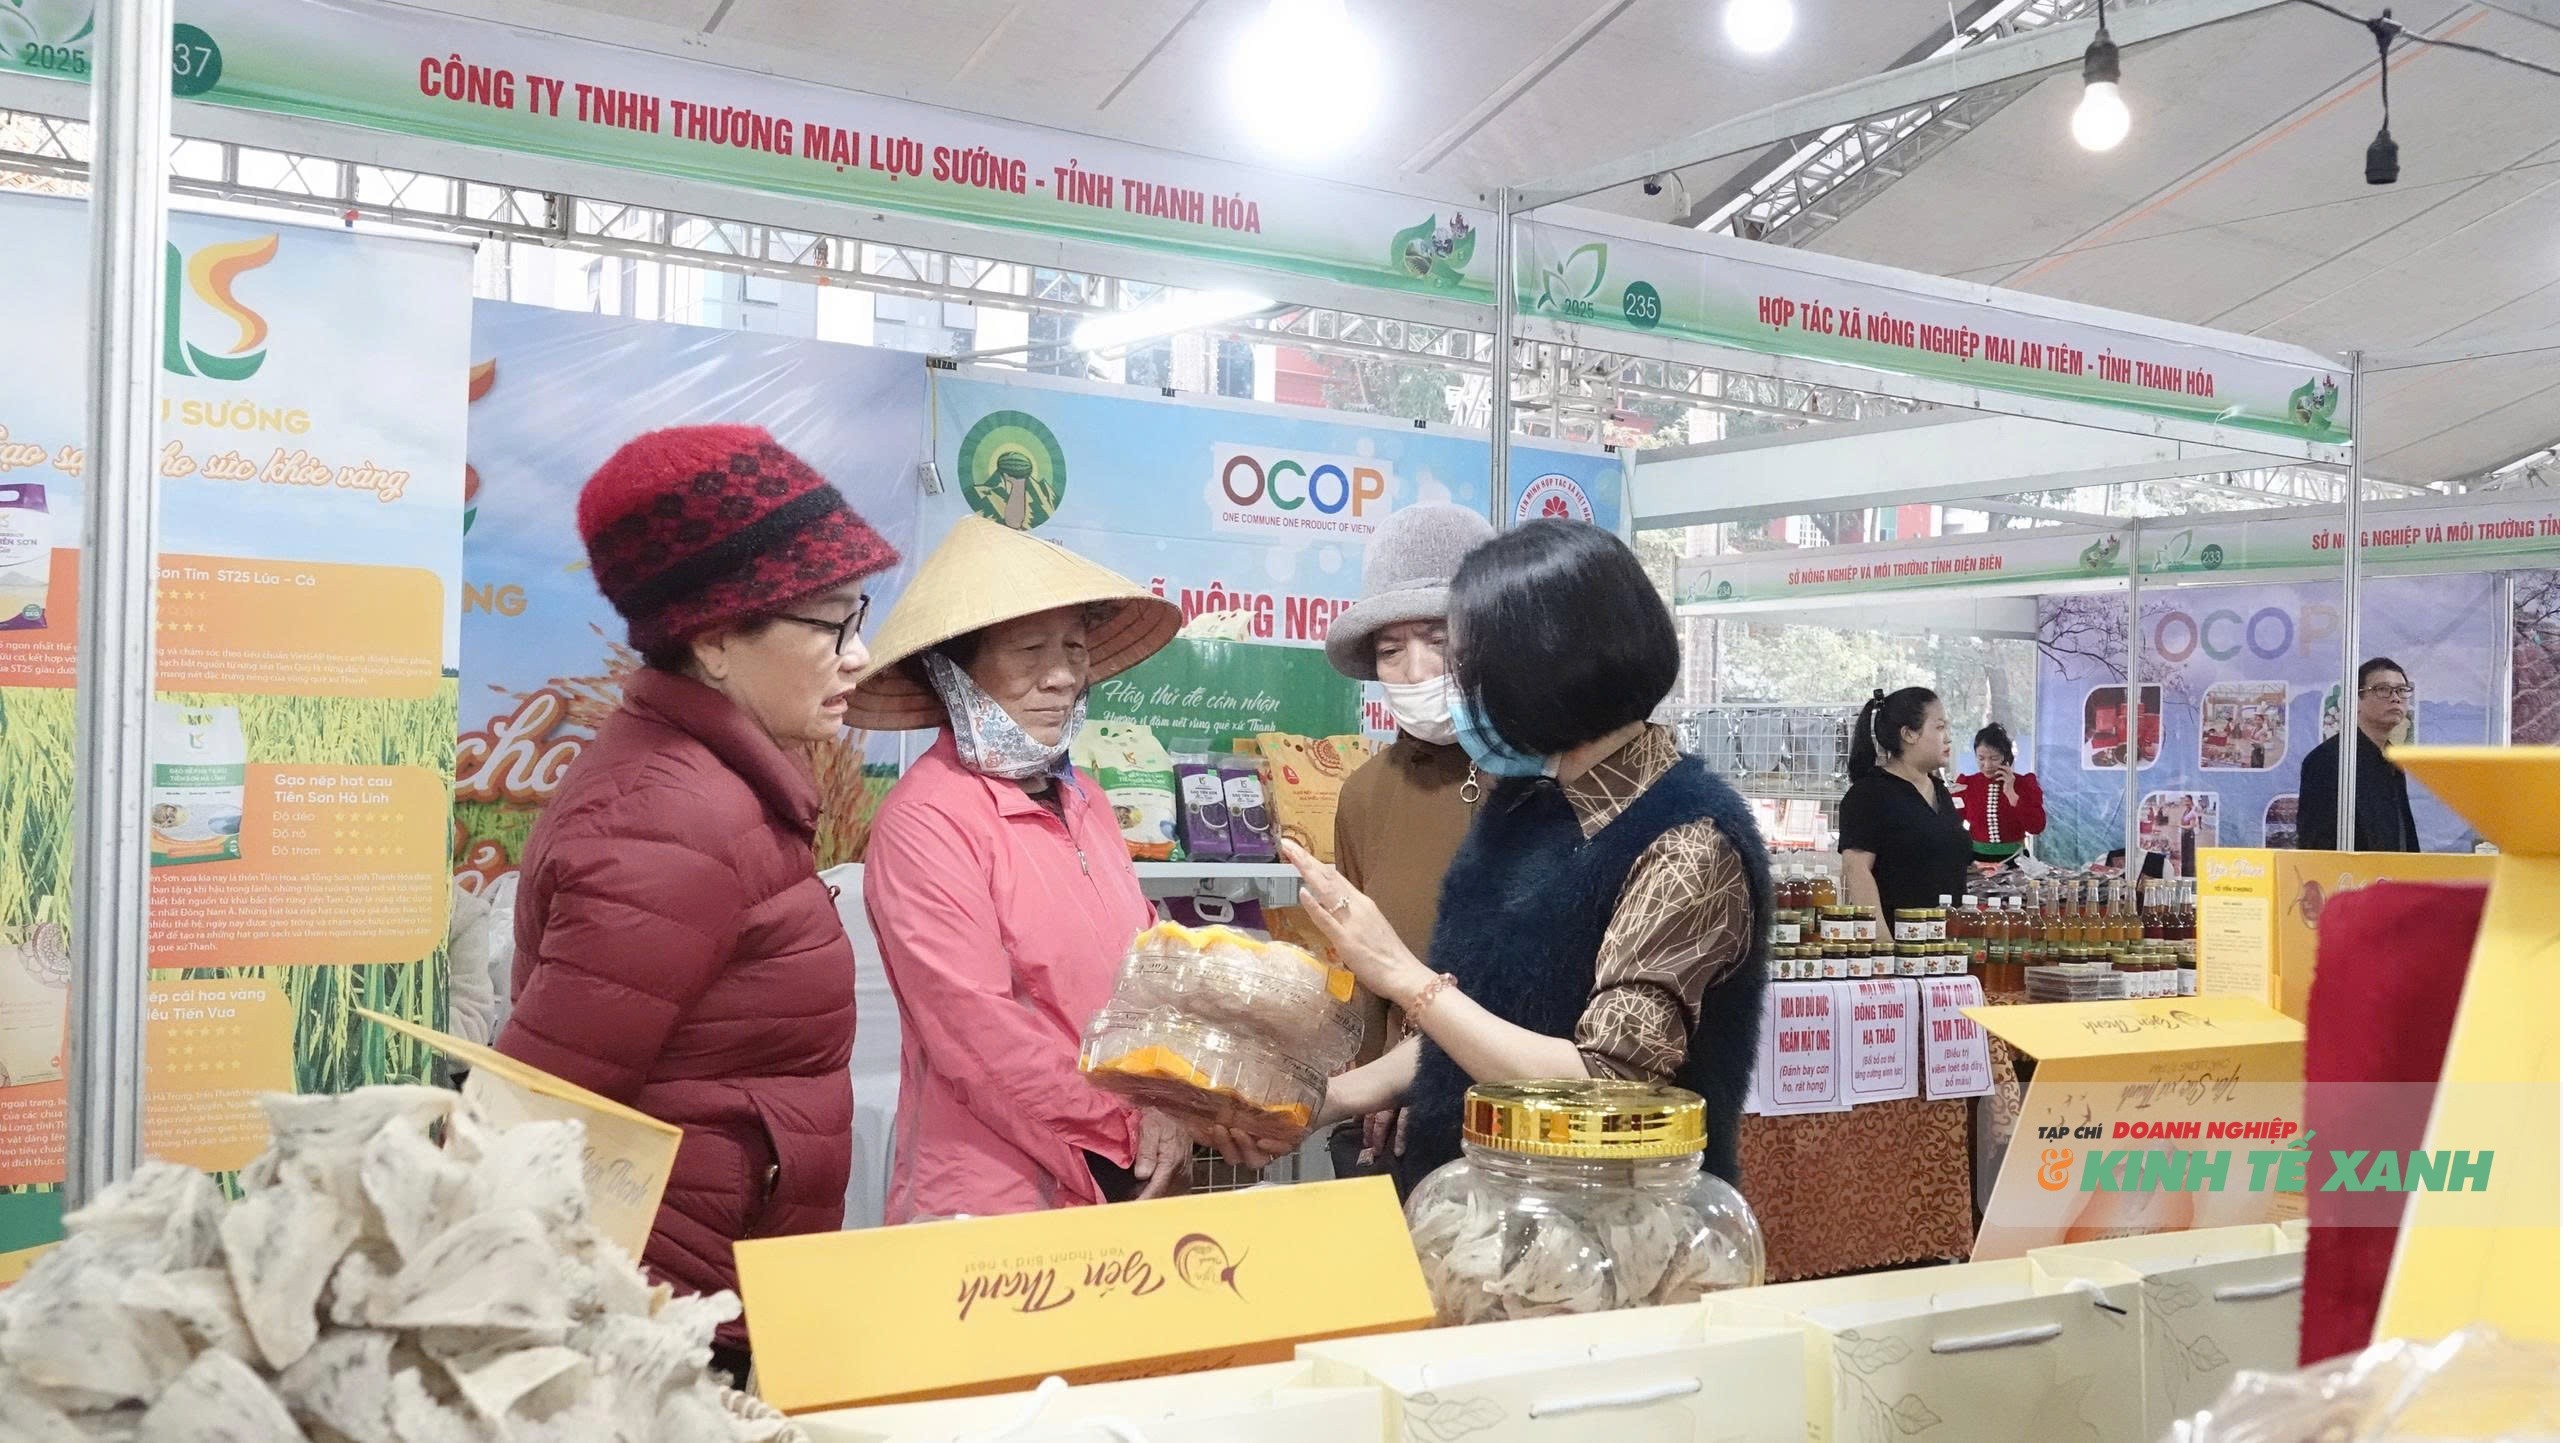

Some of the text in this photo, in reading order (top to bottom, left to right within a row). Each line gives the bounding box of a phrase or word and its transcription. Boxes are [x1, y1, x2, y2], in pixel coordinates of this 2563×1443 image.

[24, 41, 86, 75] 2025
[172, 42, 212, 77] 37
[420, 54, 1260, 234] CÔNG TY TNHH THƯƠNG MẠI LỰU SƯỚNG - TỈNH THANH HÓA
[1564, 299, 1594, 319] 2025
[1625, 292, 1656, 319] 235
[1759, 295, 1795, 333] HỢP
[1800, 302, 1834, 334] TÁC
[1839, 306, 1862, 340] XÃ
[1867, 309, 1914, 349] NÔNG
[1920, 323, 1980, 364] NGHIỆP
[1985, 335, 2016, 364] MAI
[2020, 342, 2042, 369] AN
[2046, 342, 2083, 376] TIÊM
[2098, 347, 2131, 384] TỈNH
[2136, 360, 2182, 392] THANH
[2186, 366, 2214, 399] HÓA
[182, 399, 311, 435] SƯỚNG
[201, 450, 257, 481] sức
[335, 460, 410, 503] vàng
[1222, 455, 1385, 517] OCOP
[1526, 484, 1541, 500] MINH
[1222, 512, 1239, 523] ONE
[1241, 513, 1280, 527] COMMUNE
[1282, 517, 1299, 528] ONE
[1301, 518, 1336, 531] PRODUCT
[1339, 522, 1349, 532] OF
[2312, 528, 2330, 549] SỞ
[2372, 525, 2421, 551] NGHIỆP
[2424, 521, 2442, 543] VÀ
[2446, 520, 2474, 543] MÔI
[2478, 516, 2535, 541] TRƯỜNG
[2202, 550, 2223, 564] 233
[217, 570, 250, 583] ST25
[253, 572, 280, 585] Lúa
[1788, 554, 2002, 585] SỞ NÔNG NGHIỆP VÀ MÔI TRƯỜNG TỈNH ĐIỆN BIÊN
[2154, 605, 2341, 662] OCOP
[1207, 692, 1237, 709] cảm
[1240, 690, 1281, 713] nhận
[1246, 718, 1276, 732] Thanh
[367, 776, 393, 787] cau
[308, 791, 335, 804] Sơn
[198, 990, 226, 1001] hoa
[230, 988, 266, 1002] vàng
[208, 1006, 236, 1018] Vua
[1816, 1029, 1830, 1050] ONG
[1931, 1020, 1952, 1042] TAM
[1802, 1064, 1815, 1078] bay
[1083, 1250, 1165, 1298] Yến
[956, 1268, 1075, 1321] Thanh
